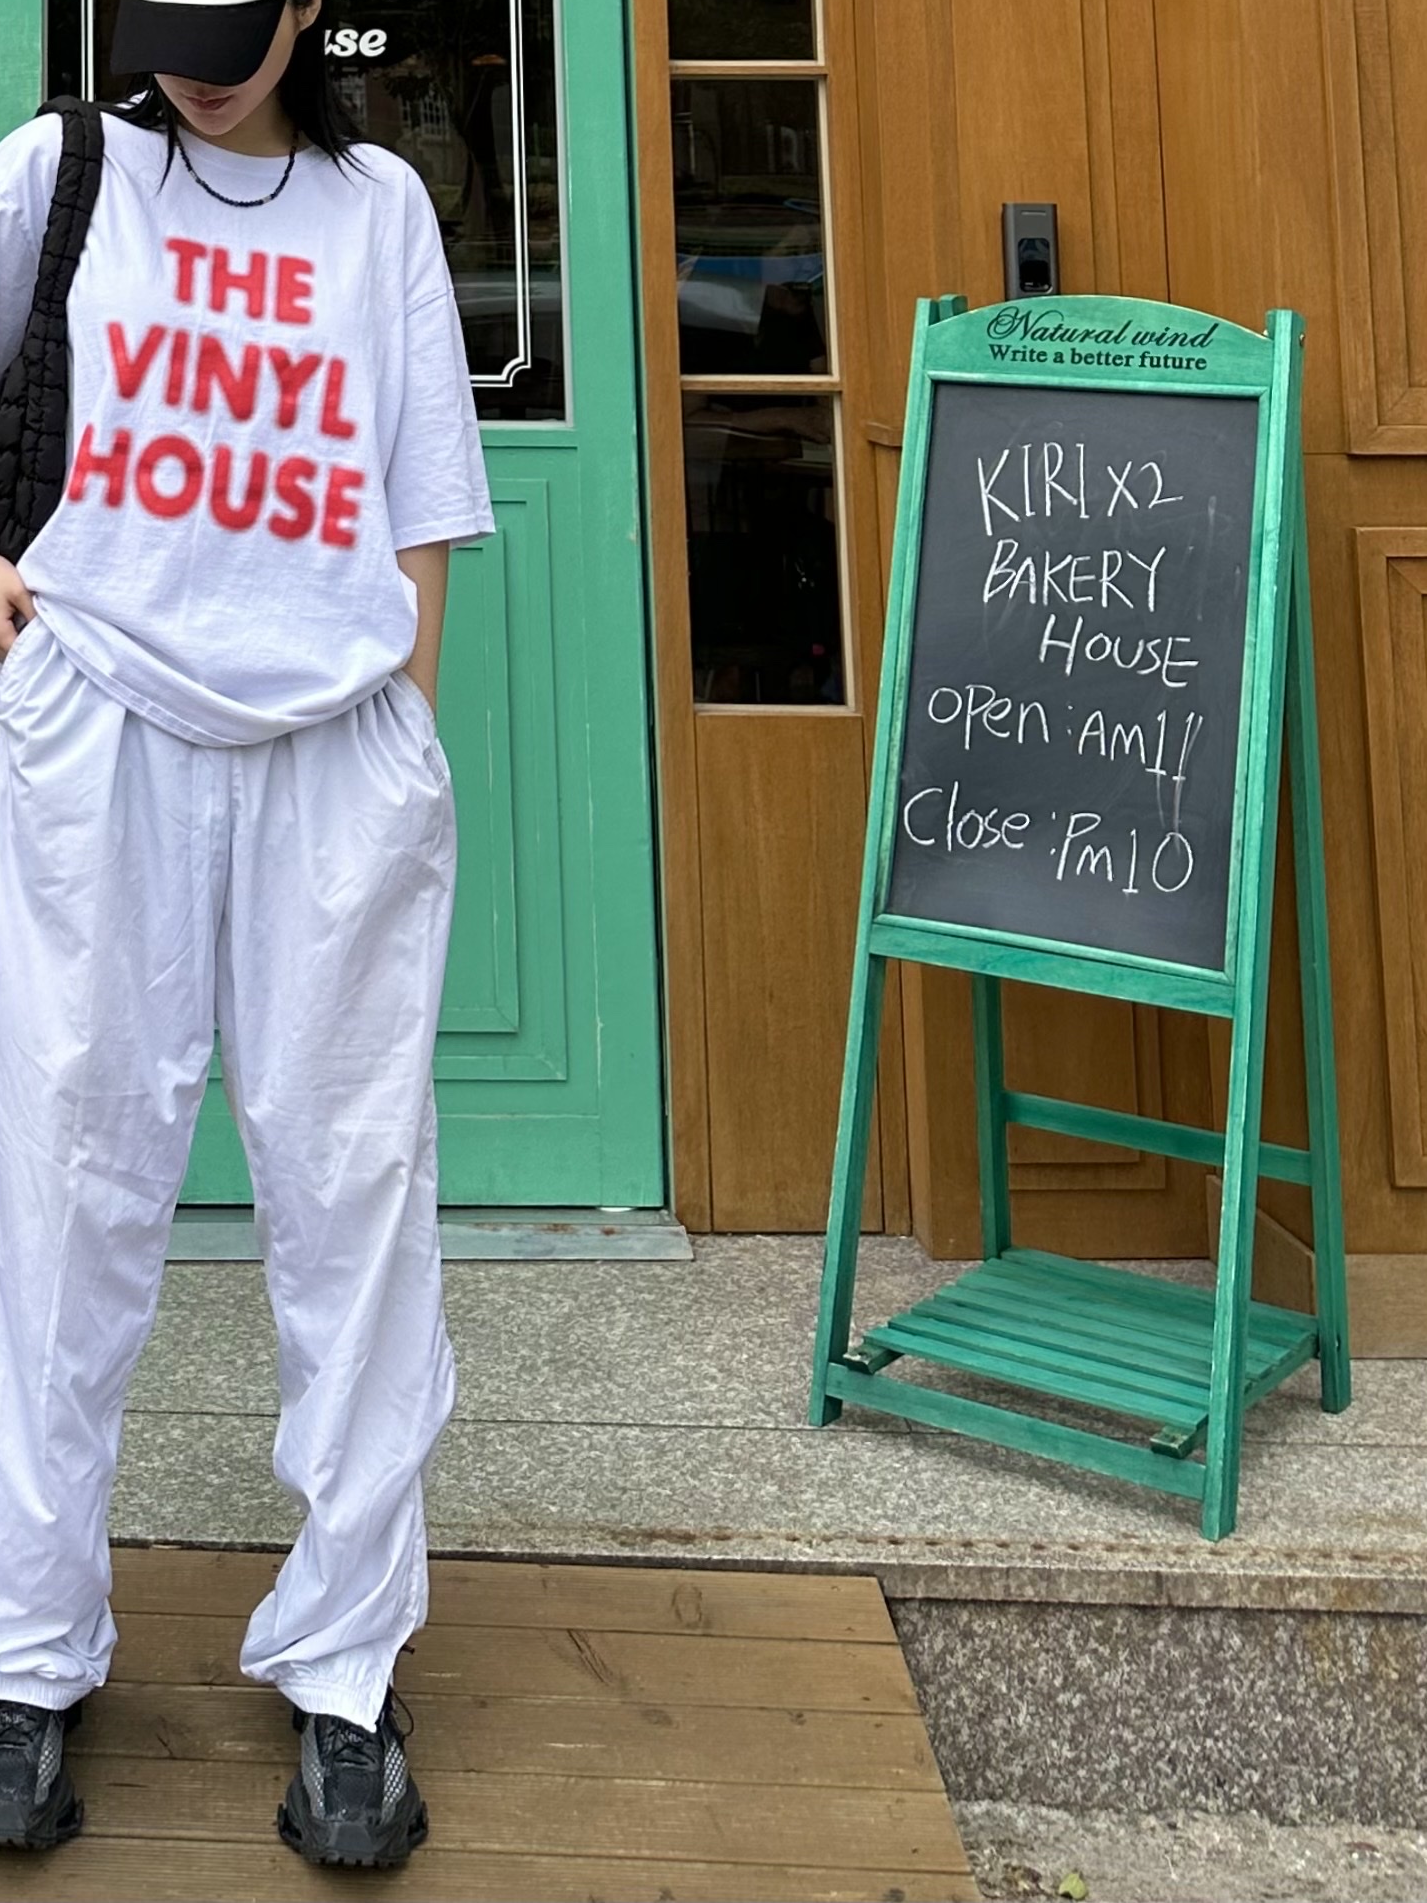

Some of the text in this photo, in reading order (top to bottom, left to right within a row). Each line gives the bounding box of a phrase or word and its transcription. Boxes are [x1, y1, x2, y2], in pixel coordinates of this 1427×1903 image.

[165, 237, 315, 325] THE
[987, 306, 1220, 348] Natural wind
[988, 344, 1208, 370] Write a better future
[107, 321, 358, 440] VINYL
[67, 422, 366, 550] HOUSE
[976, 441, 1090, 537] KIRI
[983, 538, 1167, 613] BAKERY
[1039, 613, 1200, 689] HOUSE
